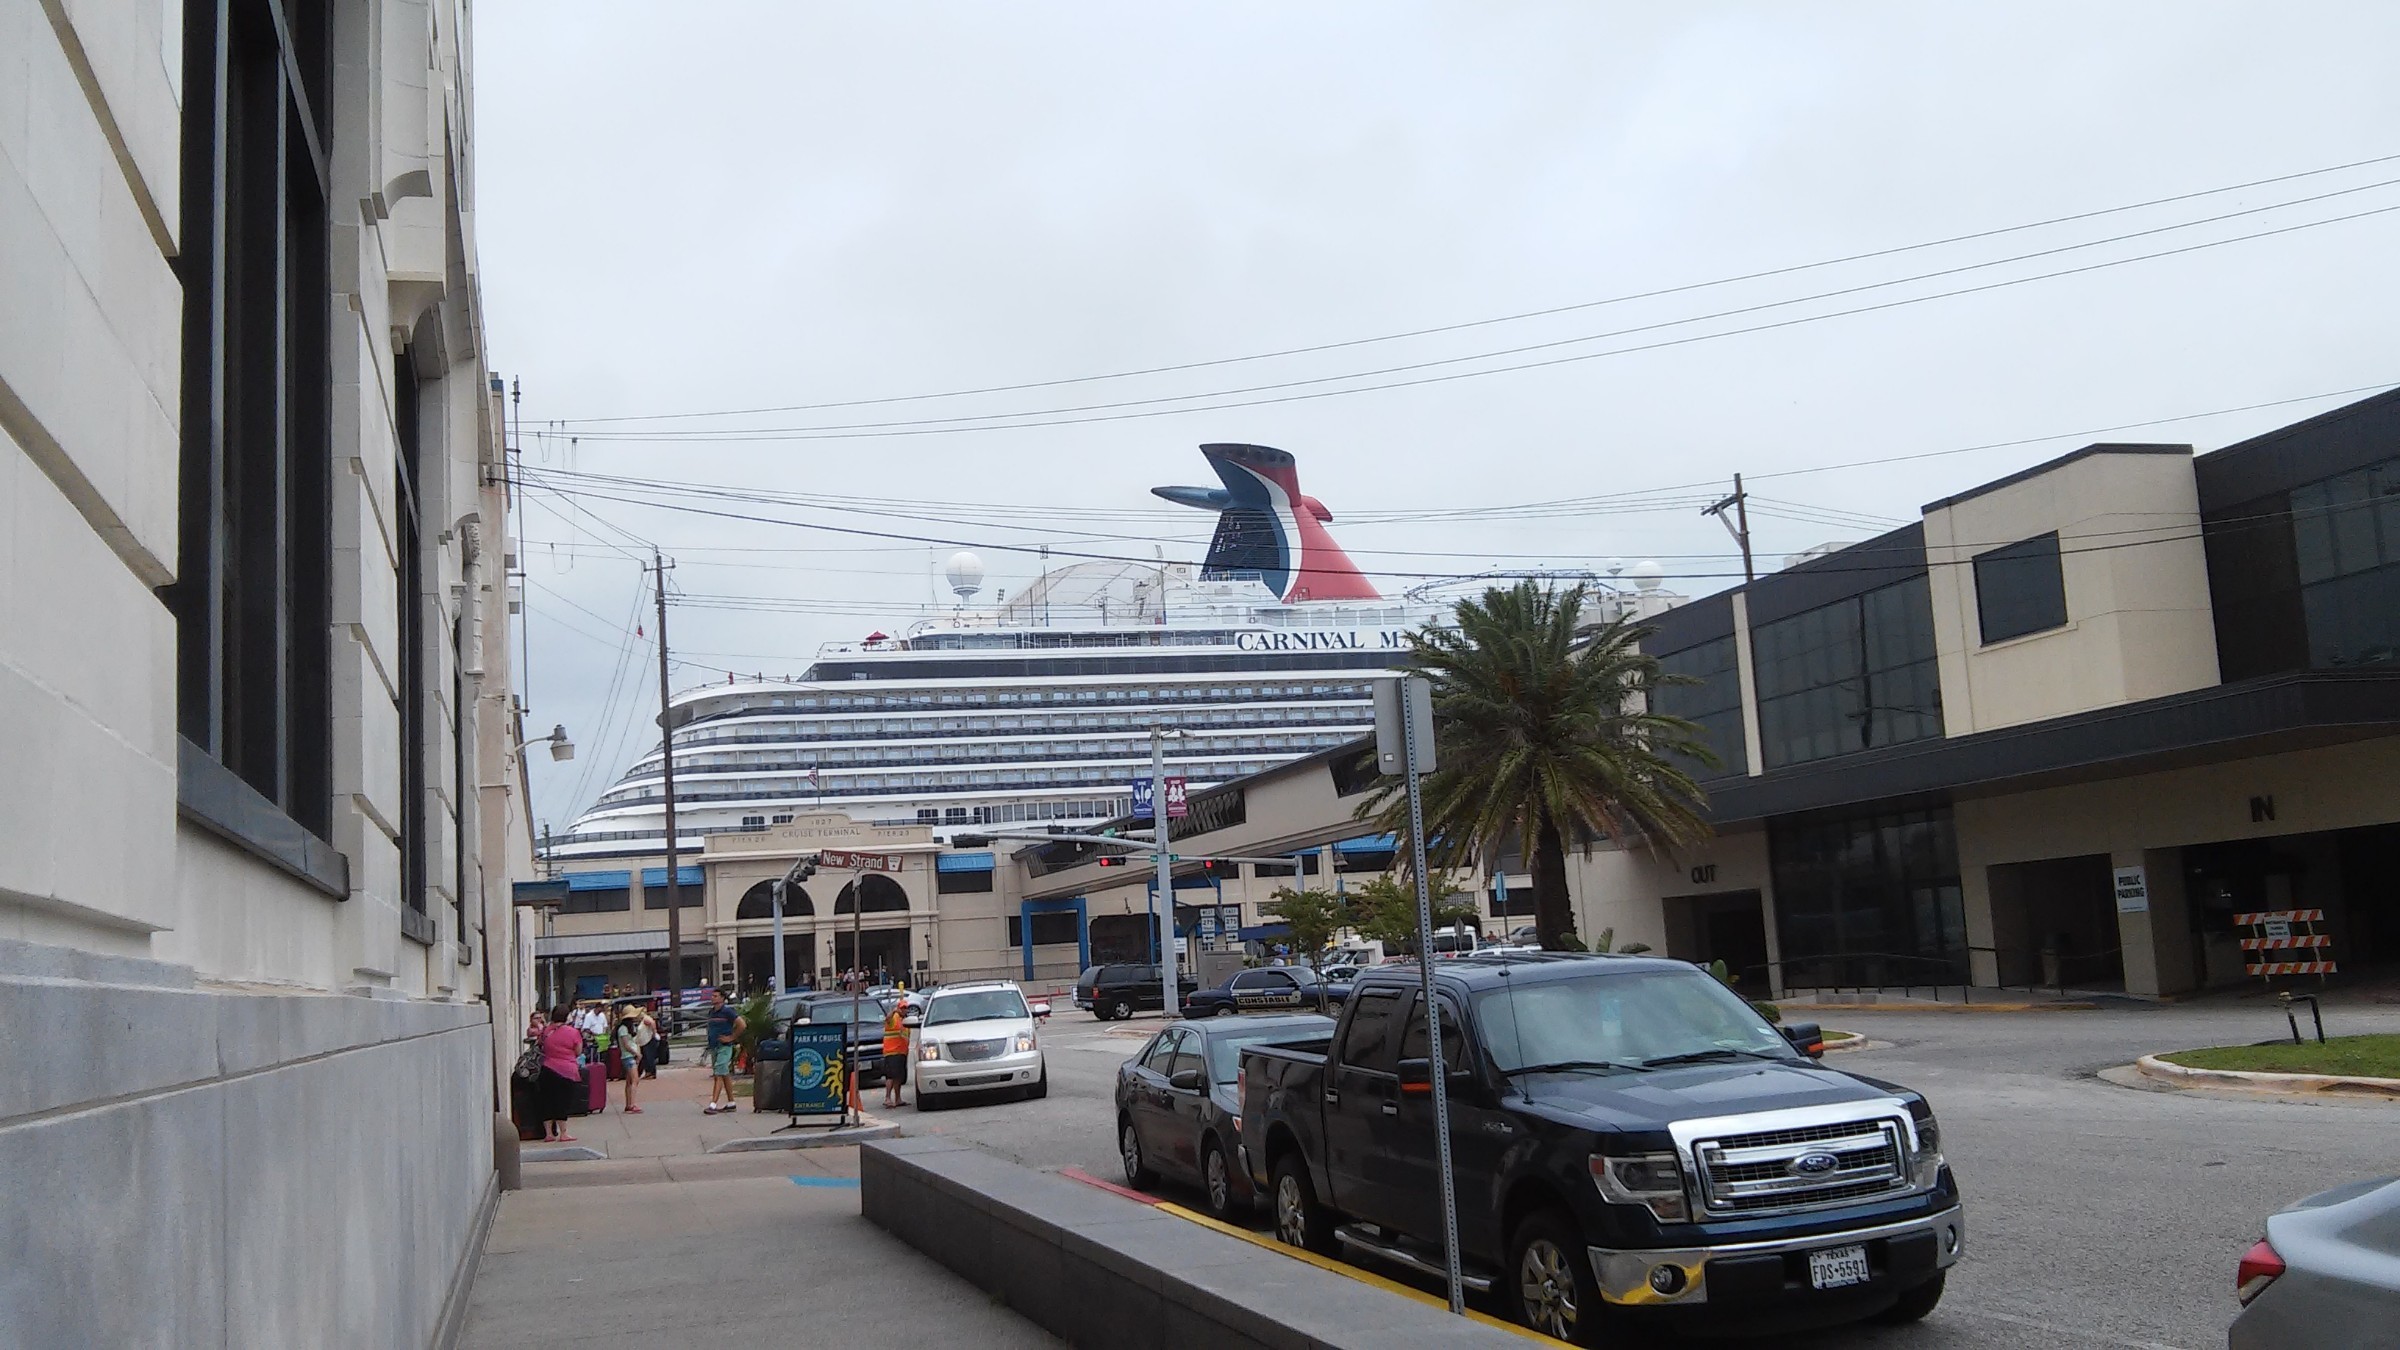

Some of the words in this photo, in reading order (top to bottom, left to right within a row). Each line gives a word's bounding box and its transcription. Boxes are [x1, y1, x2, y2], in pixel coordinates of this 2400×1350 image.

[1237, 632, 1365, 650] CARNIVAL
[2250, 795, 2275, 822] IN
[782, 829, 813, 838] CRUISE
[818, 827, 861, 837] TERMINAL
[822, 851, 845, 866] New
[849, 853, 883, 869] Strand
[1691, 865, 1717, 884] OUT
[1239, 996, 1291, 1004] CONSTABLE
[794, 1035, 811, 1043] PARK
[812, 1034, 819, 1042] N
[819, 1034, 842, 1042] CRUISE
[1826, 1249, 1849, 1260] TEXAS
